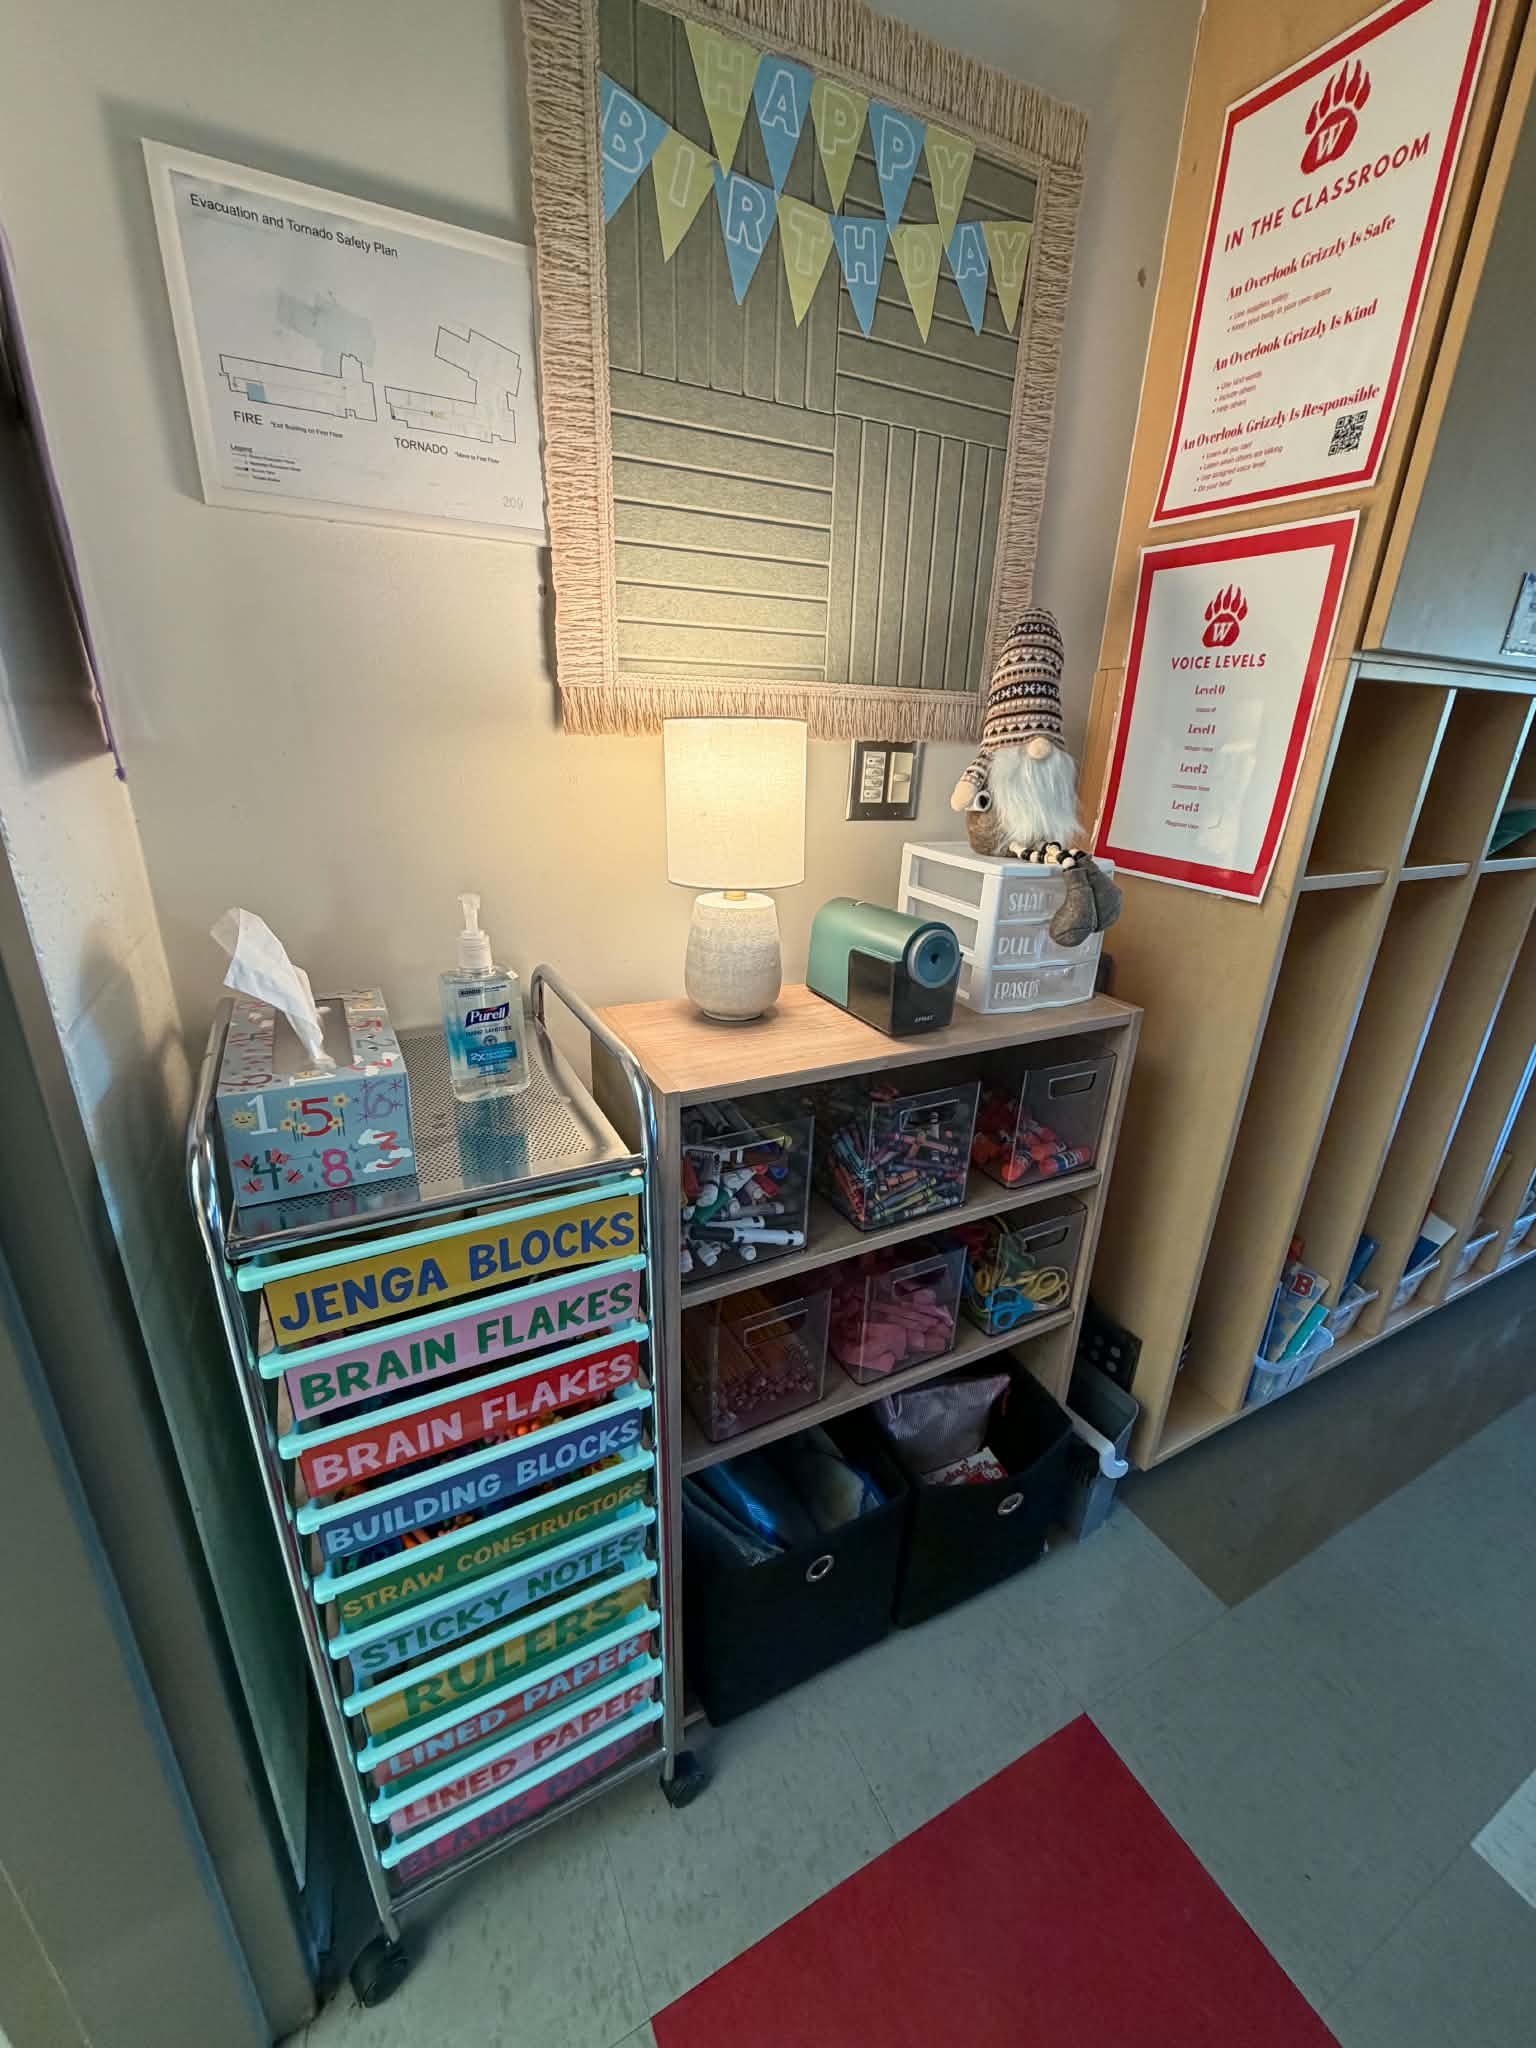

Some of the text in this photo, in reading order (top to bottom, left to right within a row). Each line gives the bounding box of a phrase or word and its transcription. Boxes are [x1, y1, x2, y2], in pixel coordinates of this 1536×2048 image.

[704, 38, 968, 212] HAPPY
[190, 193, 399, 258] Evacuation and Tornado Safety Plan
[602, 88, 1029, 288] BIRTHDAY
[1225, 132, 1430, 252] IN THE CLASSROOM
[1227, 214, 1395, 301] An Overlook Grizzly Is Safe
[1213, 298, 1377, 372] An Overlook Grizzly Is Kind
[233, 411, 263, 425] FIRE
[394, 437, 448, 455] TORNADO
[1181, 384, 1380, 453] An Overlook Grizzly Is Responsible
[1171, 653, 1266, 670] VOICE LEVELS
[1194, 684, 1218, 696] Level
[1180, 762, 1202, 774] Level
[1188, 723, 1210, 735] Level
[1172, 799, 1193, 812] Level
[471, 1006, 506, 1023] Purell
[247, 1080, 393, 1137] 1 5 6
[252, 1149, 282, 1190] 4
[321, 1148, 352, 1188] 8
[279, 1211, 635, 1331] JENGA BLOCKS
[299, 1283, 633, 1410] BRAIN FLAKES
[310, 1353, 633, 1490] BRAIN FLAKES
[325, 1418, 640, 1556] BUILDING BLOCKS
[343, 1477, 648, 1619] STRAW CONSTRUCTORS
[360, 1531, 644, 1670] STICKY NOTES
[403, 1596, 626, 1719] RULERS
[388, 1637, 642, 1776] LINED PAPER
[404, 1683, 651, 1825] LINED PAPER
